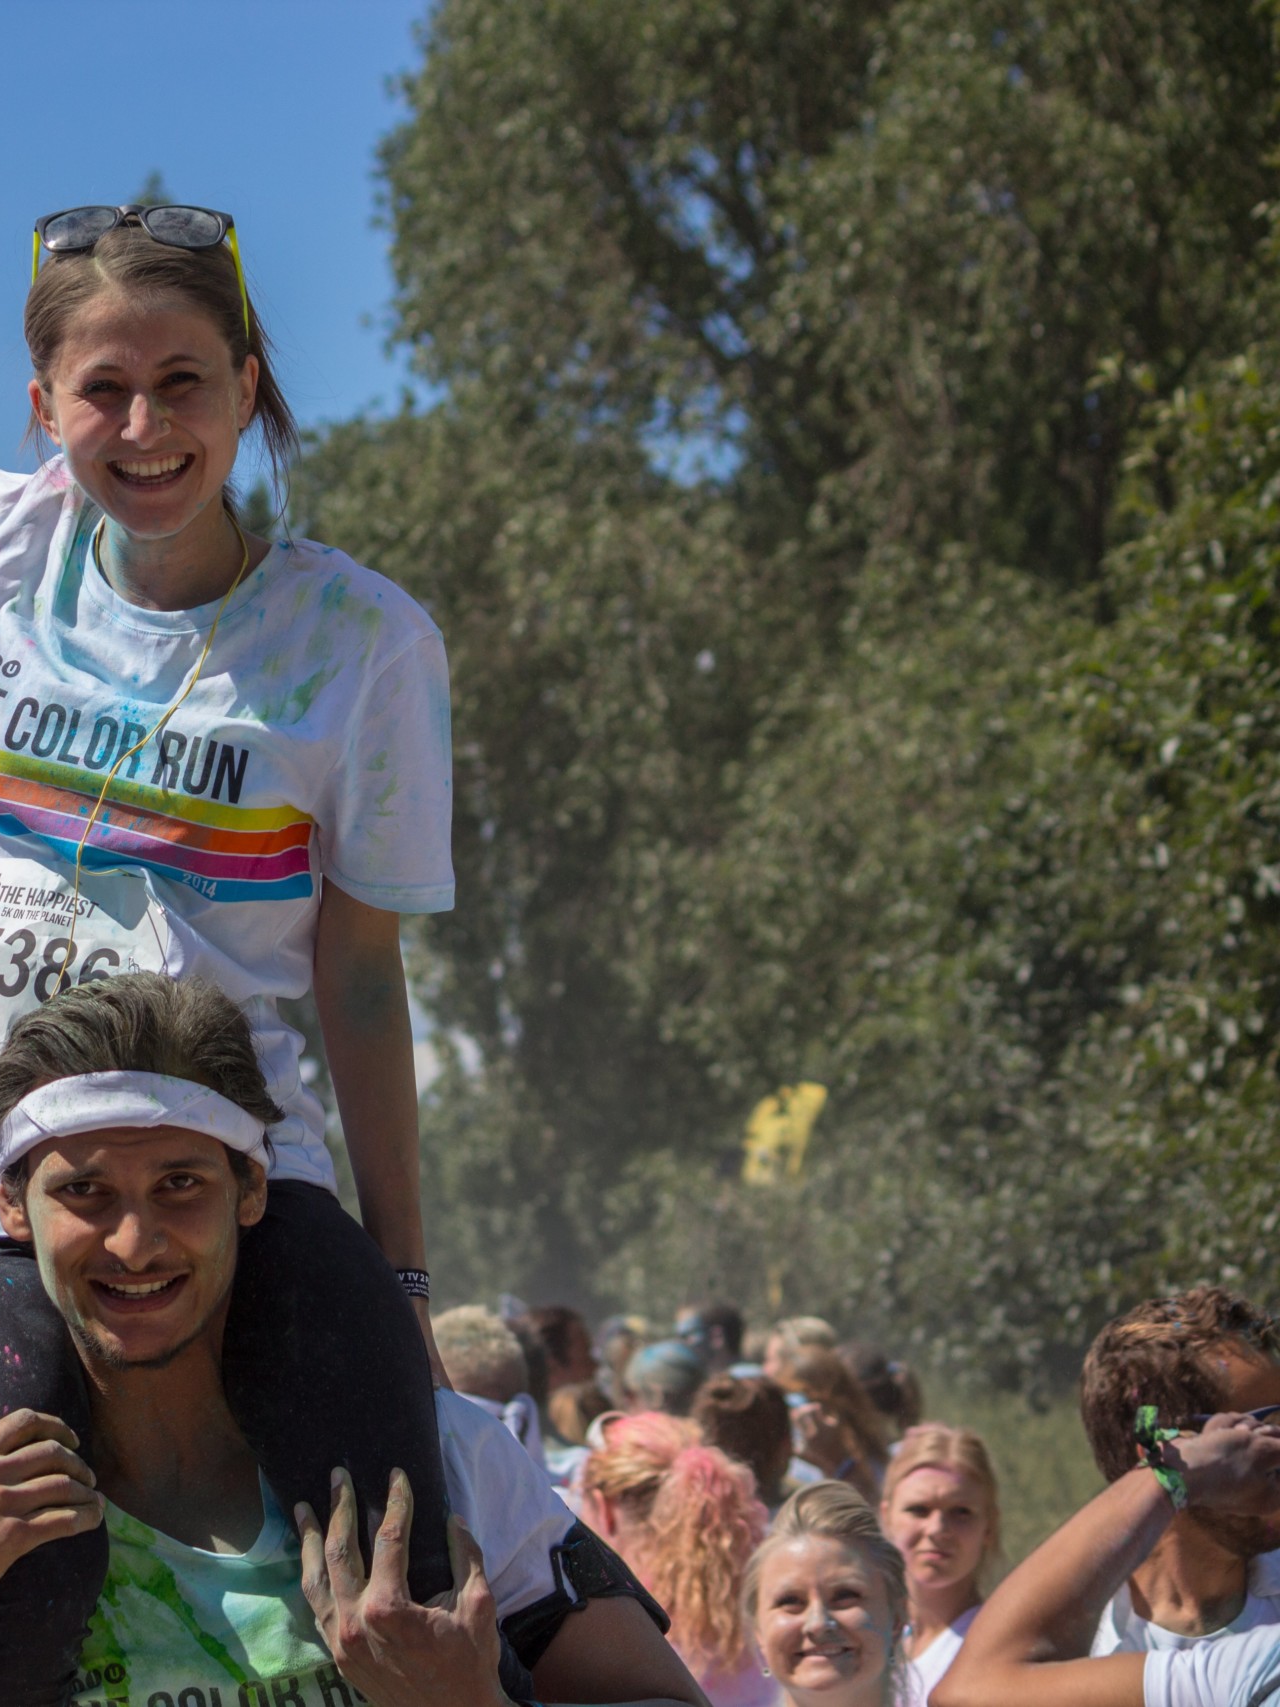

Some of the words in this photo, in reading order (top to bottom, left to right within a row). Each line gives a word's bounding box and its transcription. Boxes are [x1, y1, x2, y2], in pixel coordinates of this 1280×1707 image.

[4, 696, 147, 779] COLOR
[150, 729, 249, 804] RUN
[182, 873, 217, 898] 2014
[1, 906, 13, 918] 5K
[12, 908, 25, 919] ON
[24, 909, 40, 921] THE
[39, 911, 73, 927] PLANET
[25, 887, 99, 918] HAPPIEST
